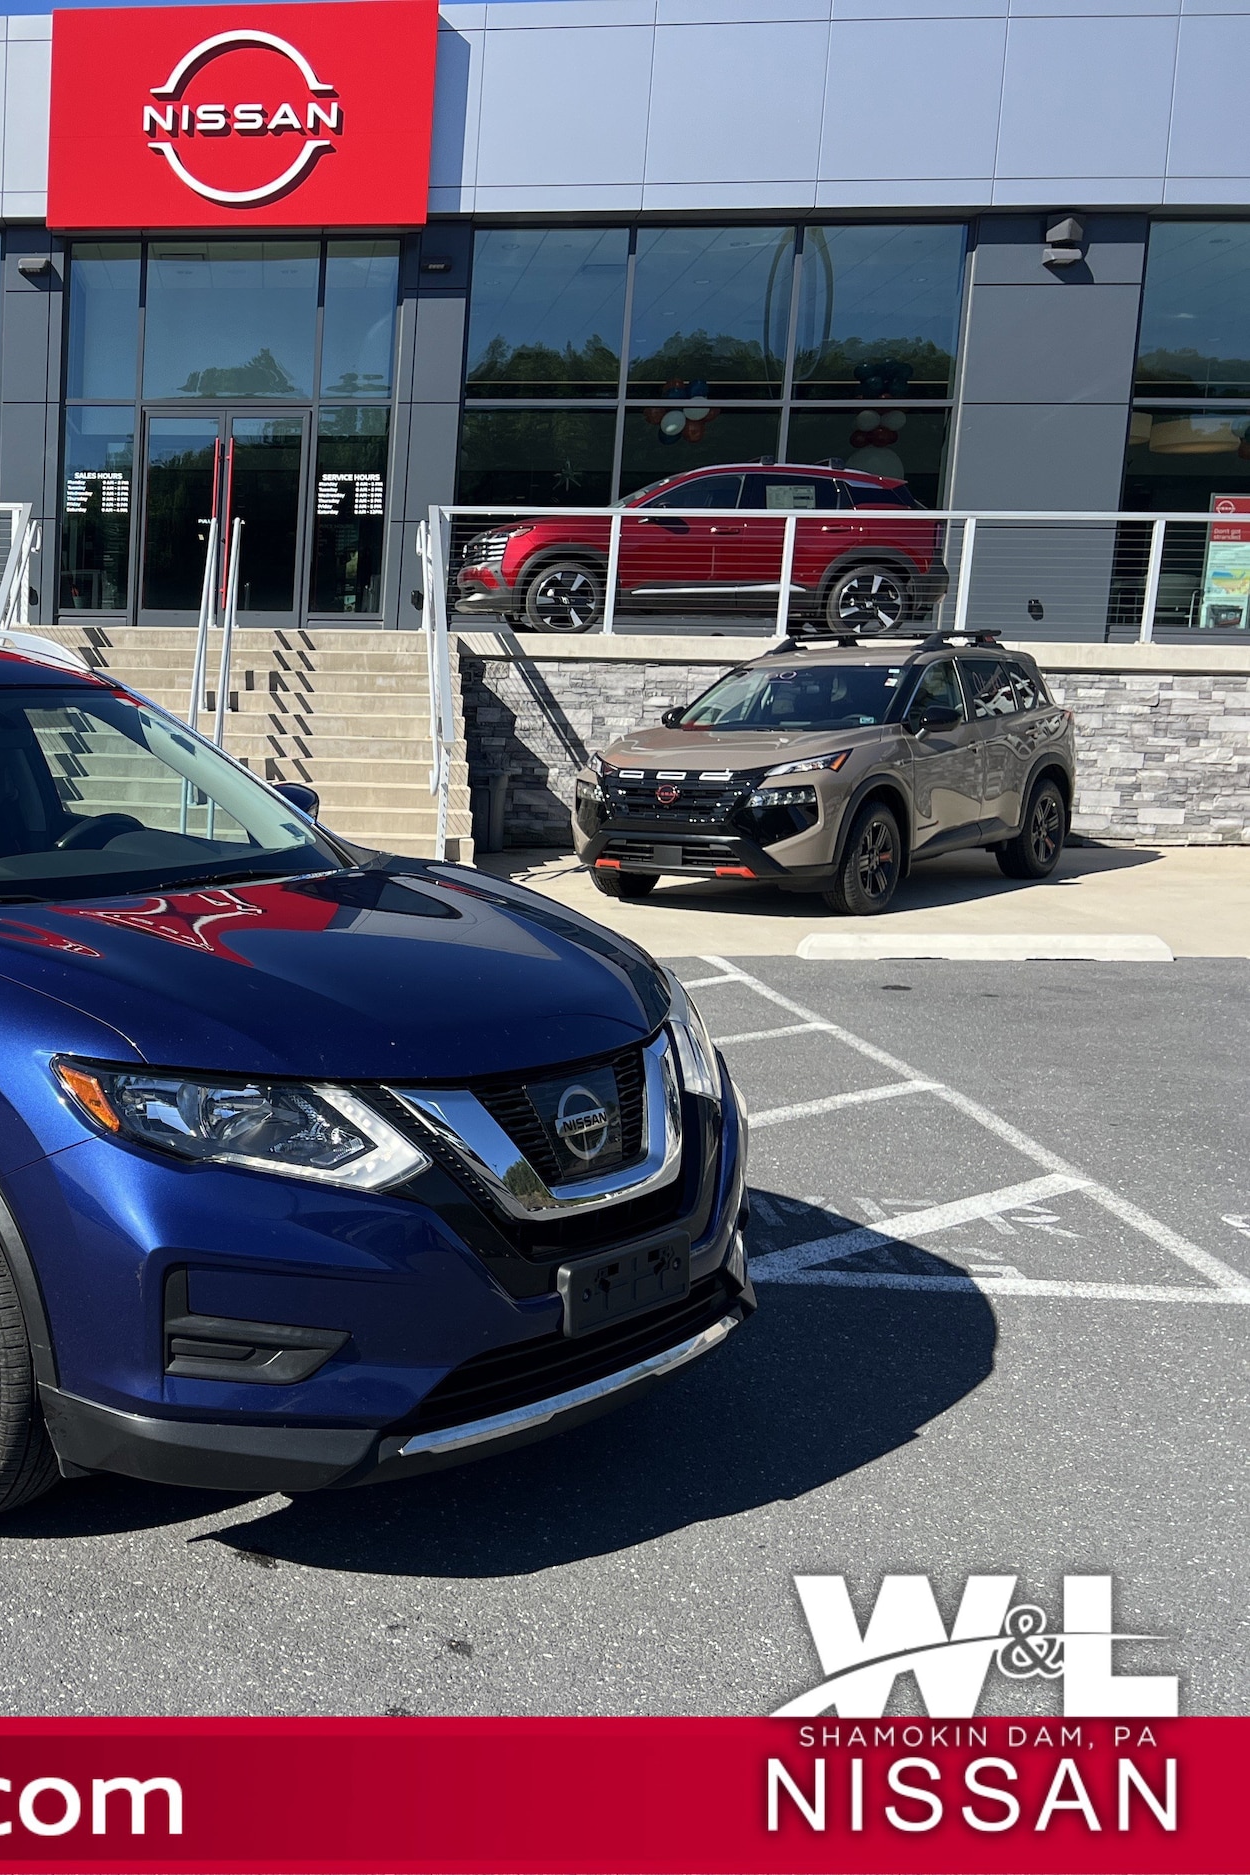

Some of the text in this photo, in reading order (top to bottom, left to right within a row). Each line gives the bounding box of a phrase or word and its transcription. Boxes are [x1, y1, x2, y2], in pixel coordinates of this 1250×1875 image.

[143, 102, 342, 136] NISSAN
[74, 472, 96, 480] SALES
[562, 1111, 608, 1133] NISSAN
